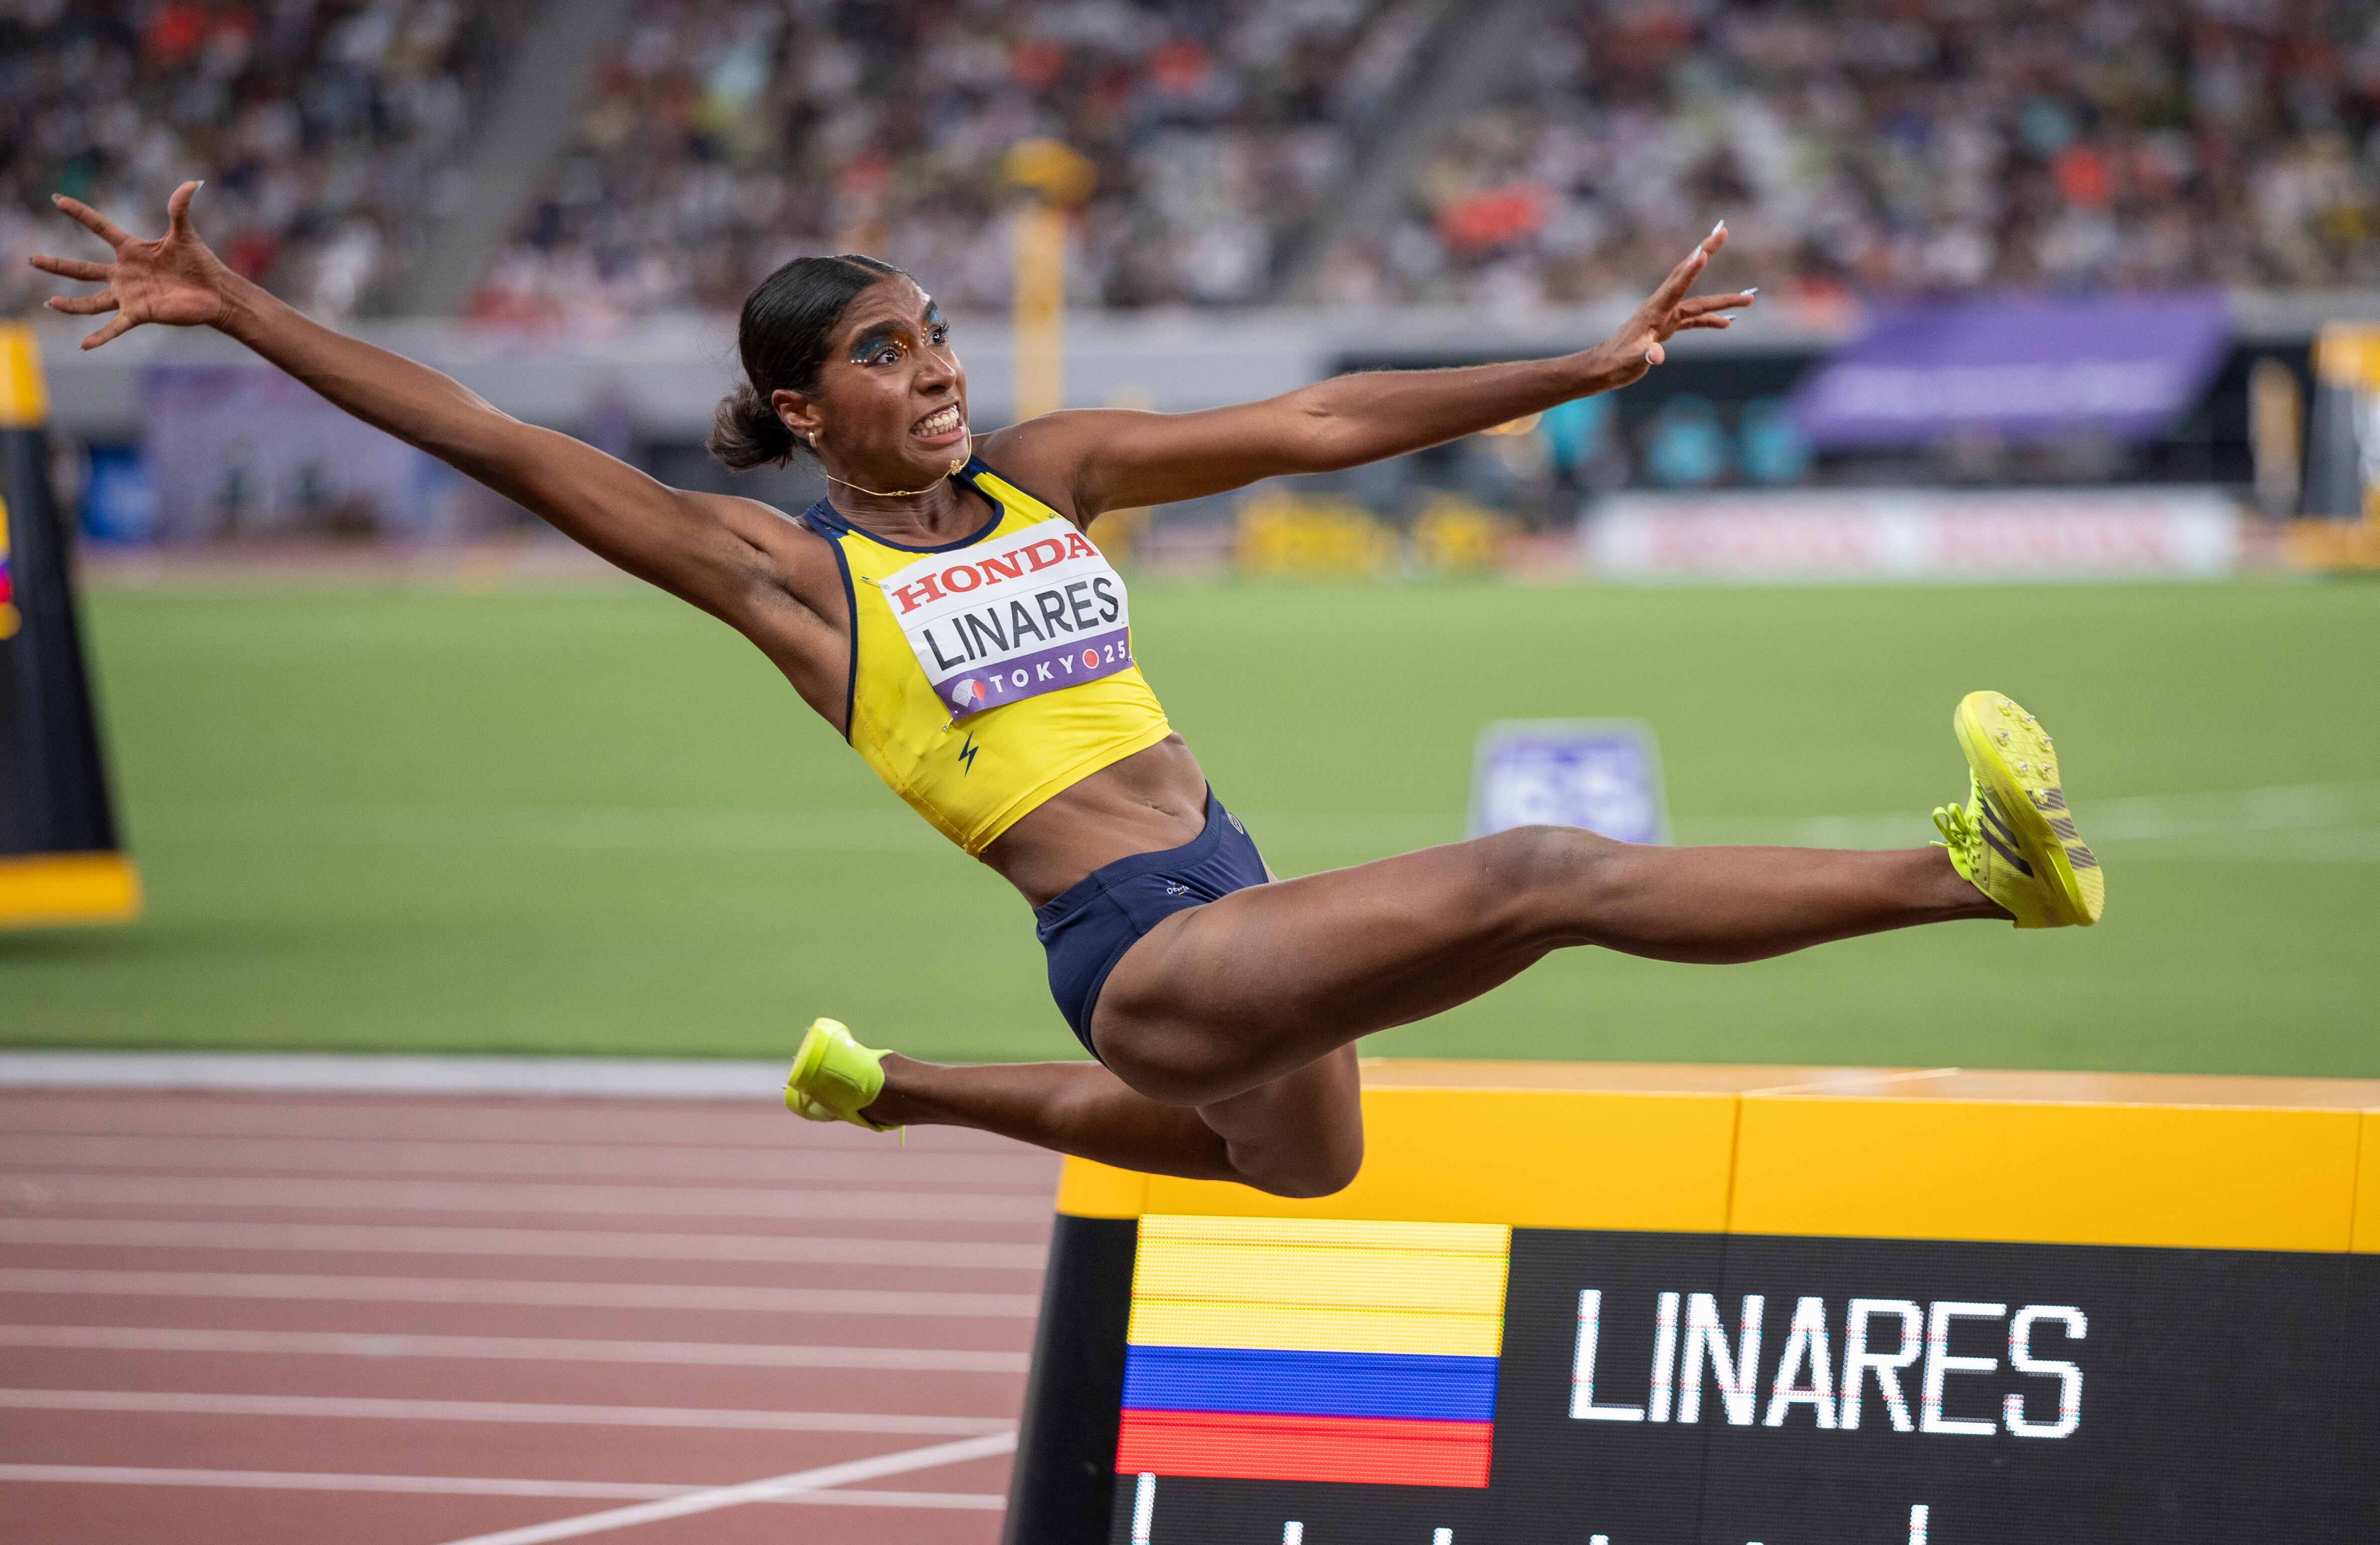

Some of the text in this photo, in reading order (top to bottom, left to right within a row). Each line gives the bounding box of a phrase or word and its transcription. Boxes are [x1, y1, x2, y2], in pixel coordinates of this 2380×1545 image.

[892, 533, 1099, 615] HONDA
[923, 577, 1119, 671] LINARES
[1104, 640, 1125, 664] 25
[1569, 1289, 2087, 1438] LINARES
